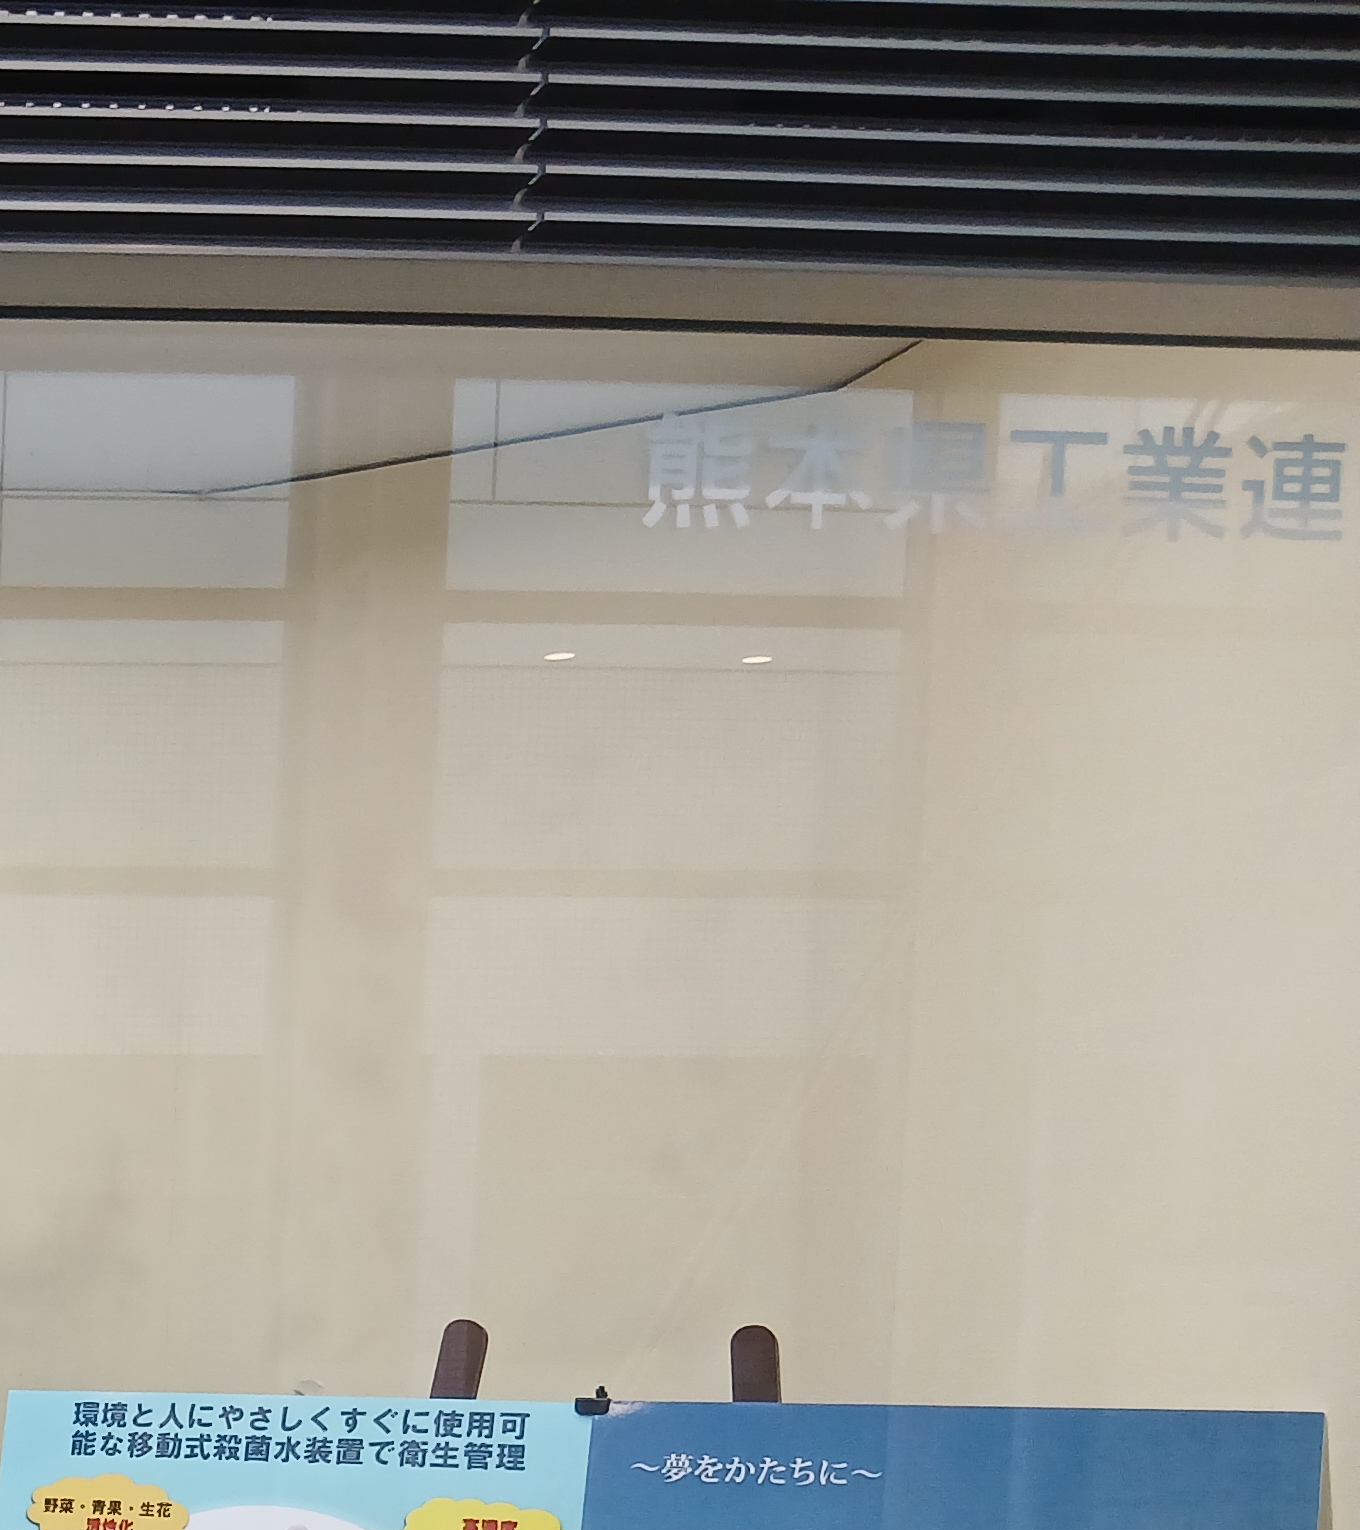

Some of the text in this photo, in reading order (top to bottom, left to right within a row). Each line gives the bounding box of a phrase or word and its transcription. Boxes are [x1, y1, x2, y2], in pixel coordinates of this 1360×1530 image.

[642, 412, 1346, 540] 熊本県工業連
[71, 1401, 530, 1440] 環境と人にやさしくすぐに使用可
[70, 1431, 527, 1471] 能な移動式殺菌水装置で衛生管理
[43, 1498, 173, 1518] 野菜・青果・生花
